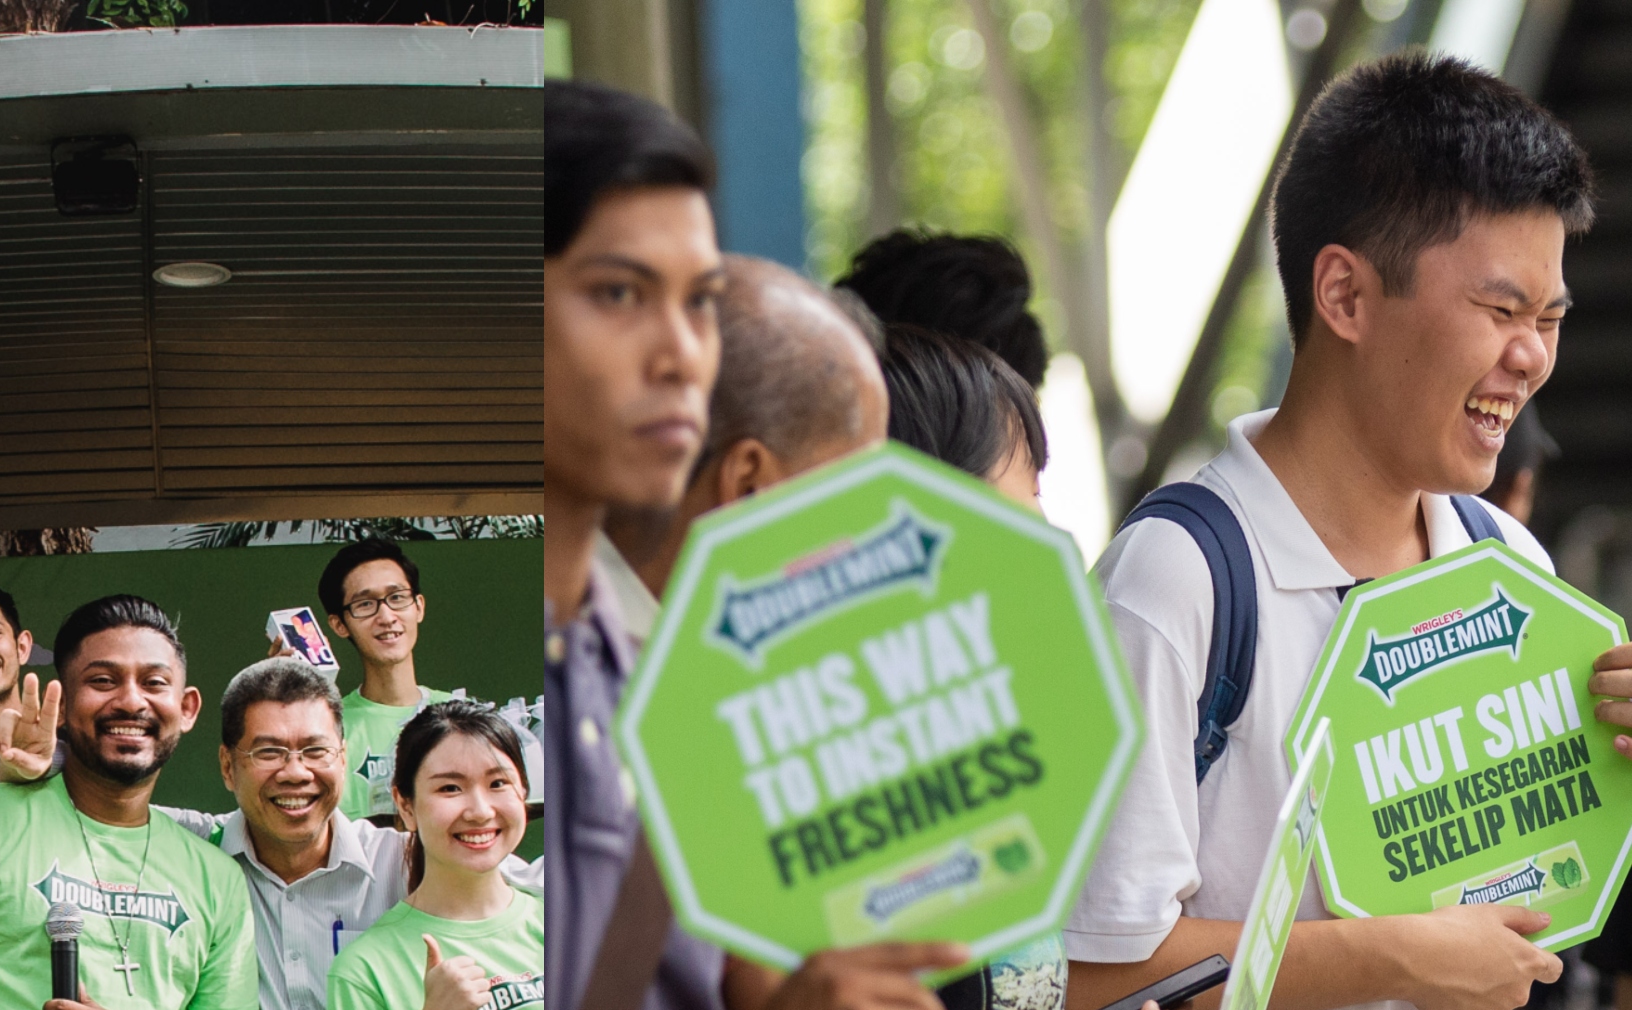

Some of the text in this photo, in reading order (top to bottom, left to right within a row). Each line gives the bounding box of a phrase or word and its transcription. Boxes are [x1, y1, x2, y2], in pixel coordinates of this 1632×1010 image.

[716, 591, 996, 766] THIS WAY
[1373, 603, 1514, 684] DOUBLEMINT
[1412, 609, 1464, 635] WRIGLEY'S
[744, 665, 1020, 828] TO INSTANT
[1354, 667, 1582, 805] IKUT SINI
[1372, 784, 1456, 840] UNTUK
[1454, 733, 1591, 811] KESEGARAN
[769, 729, 1045, 889] FRESHNESS
[1383, 803, 1507, 883] SEKELIP
[1510, 770, 1603, 837] MATA
[51, 877, 179, 926] DOUBLEMINT
